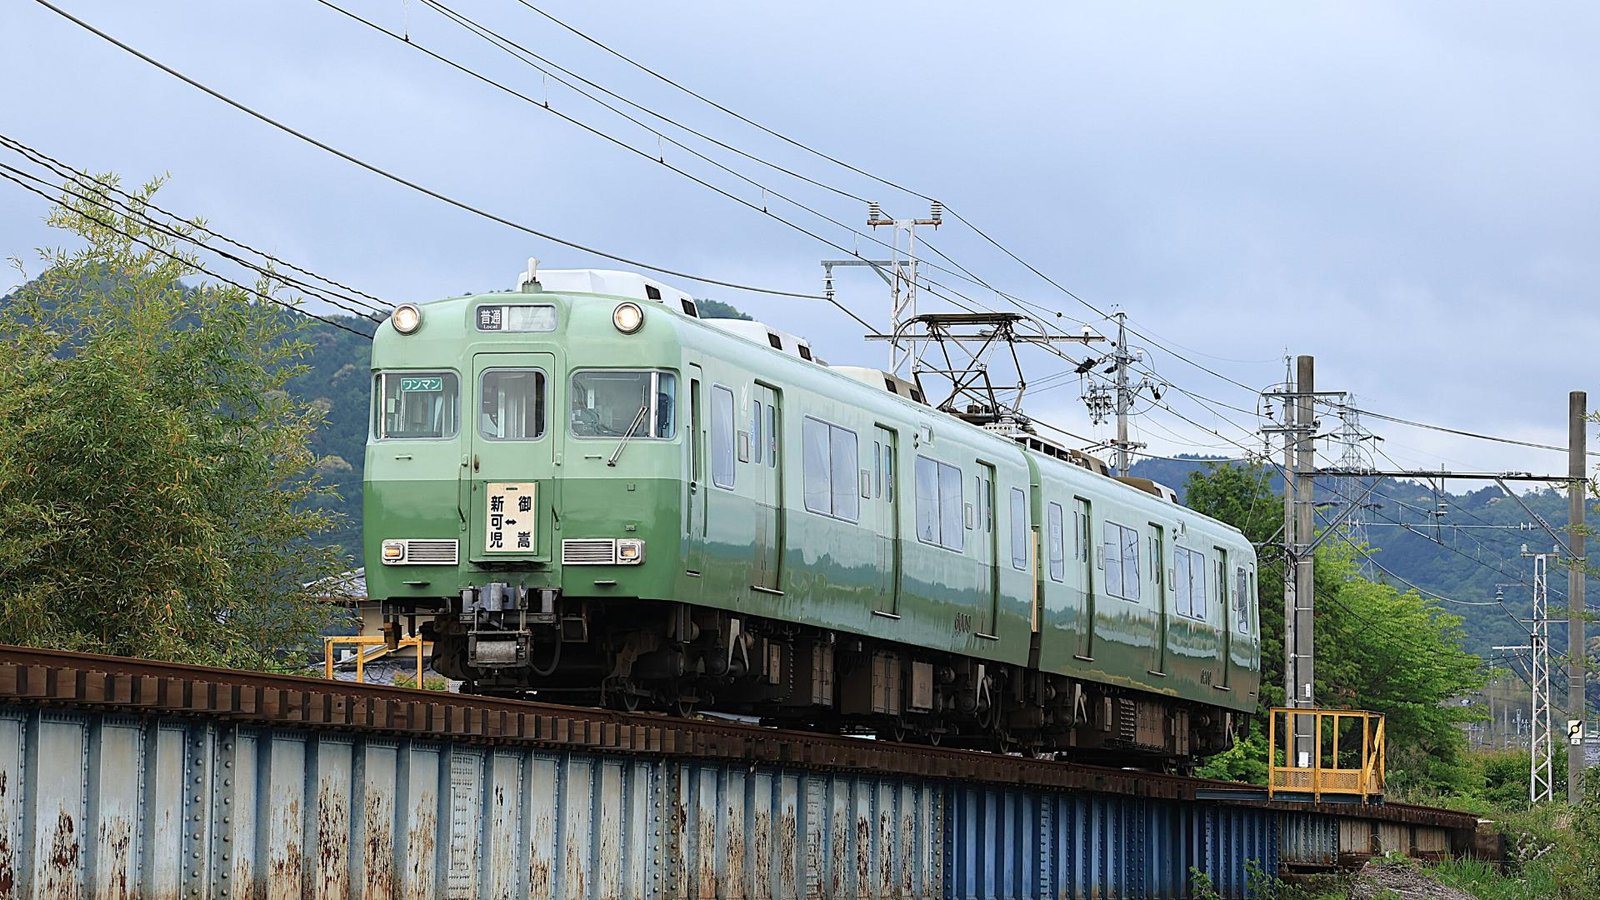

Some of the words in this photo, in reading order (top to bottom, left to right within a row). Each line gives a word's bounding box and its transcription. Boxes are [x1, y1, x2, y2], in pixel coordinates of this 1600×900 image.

[480, 309, 500, 324] 普通
[402, 379, 440, 390] ワンマン
[489, 496, 504, 548] 新可児
[518, 496, 532, 548] 御嵩
